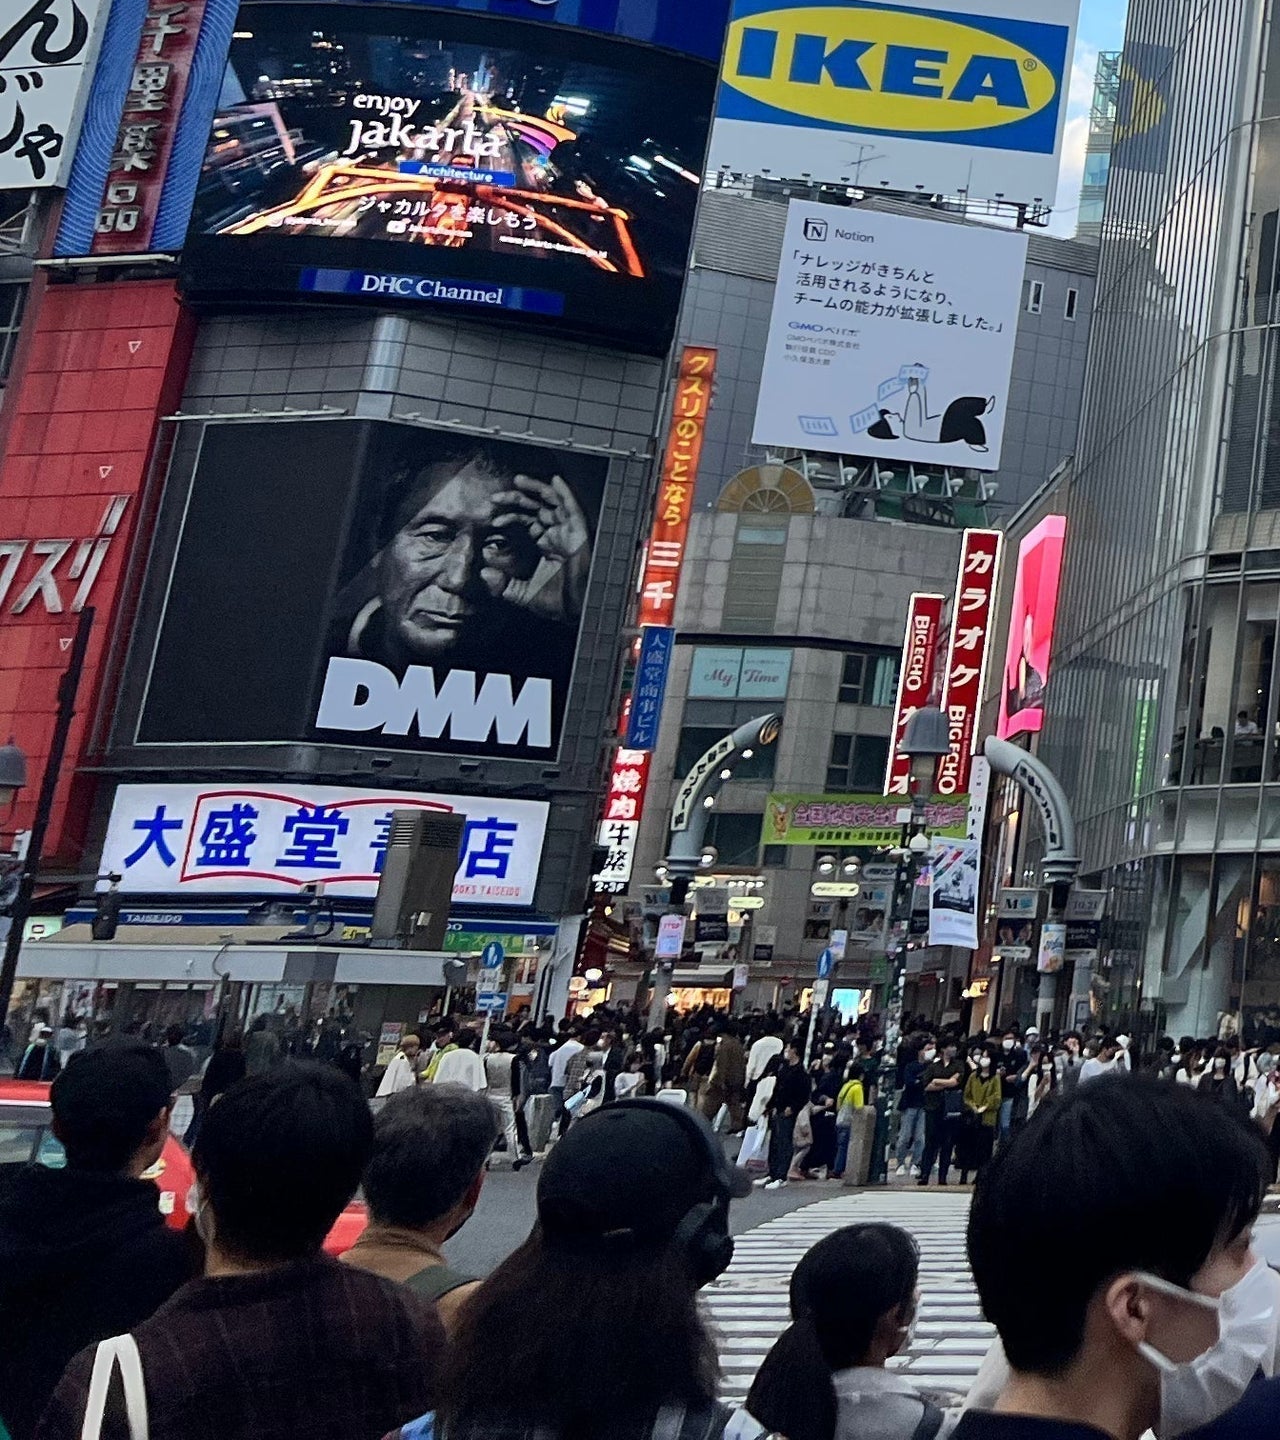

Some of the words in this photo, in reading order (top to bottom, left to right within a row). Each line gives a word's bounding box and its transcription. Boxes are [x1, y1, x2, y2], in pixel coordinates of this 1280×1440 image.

[736, 27, 1029, 109] IKEA
[353, 93, 421, 117] enjoy
[344, 113, 503, 159] jakarta
[418, 165, 493, 182] Architecture
[835, 228, 875, 244] Notion
[793, 249, 936, 284] 「ナレッジがきちんと
[361, 275, 414, 295] DHC
[416, 279, 503, 305] Channel
[796, 271, 954, 306] 活用されるようになり、
[793, 292, 1003, 334] チームの能力が拡張しました。」
[914, 614, 931, 645] BIG
[950, 550, 993, 688] カラオケ
[744, 669, 779, 684] Time
[906, 646, 926, 691] ECHO
[315, 657, 553, 748] DMM
[948, 705, 967, 740] BIG
[939, 742, 961, 795] ECHO
[124, 803, 518, 879] 大盛堂店
[452, 884, 477, 895] OOKS
[479, 884, 521, 897] TAISEIDO
